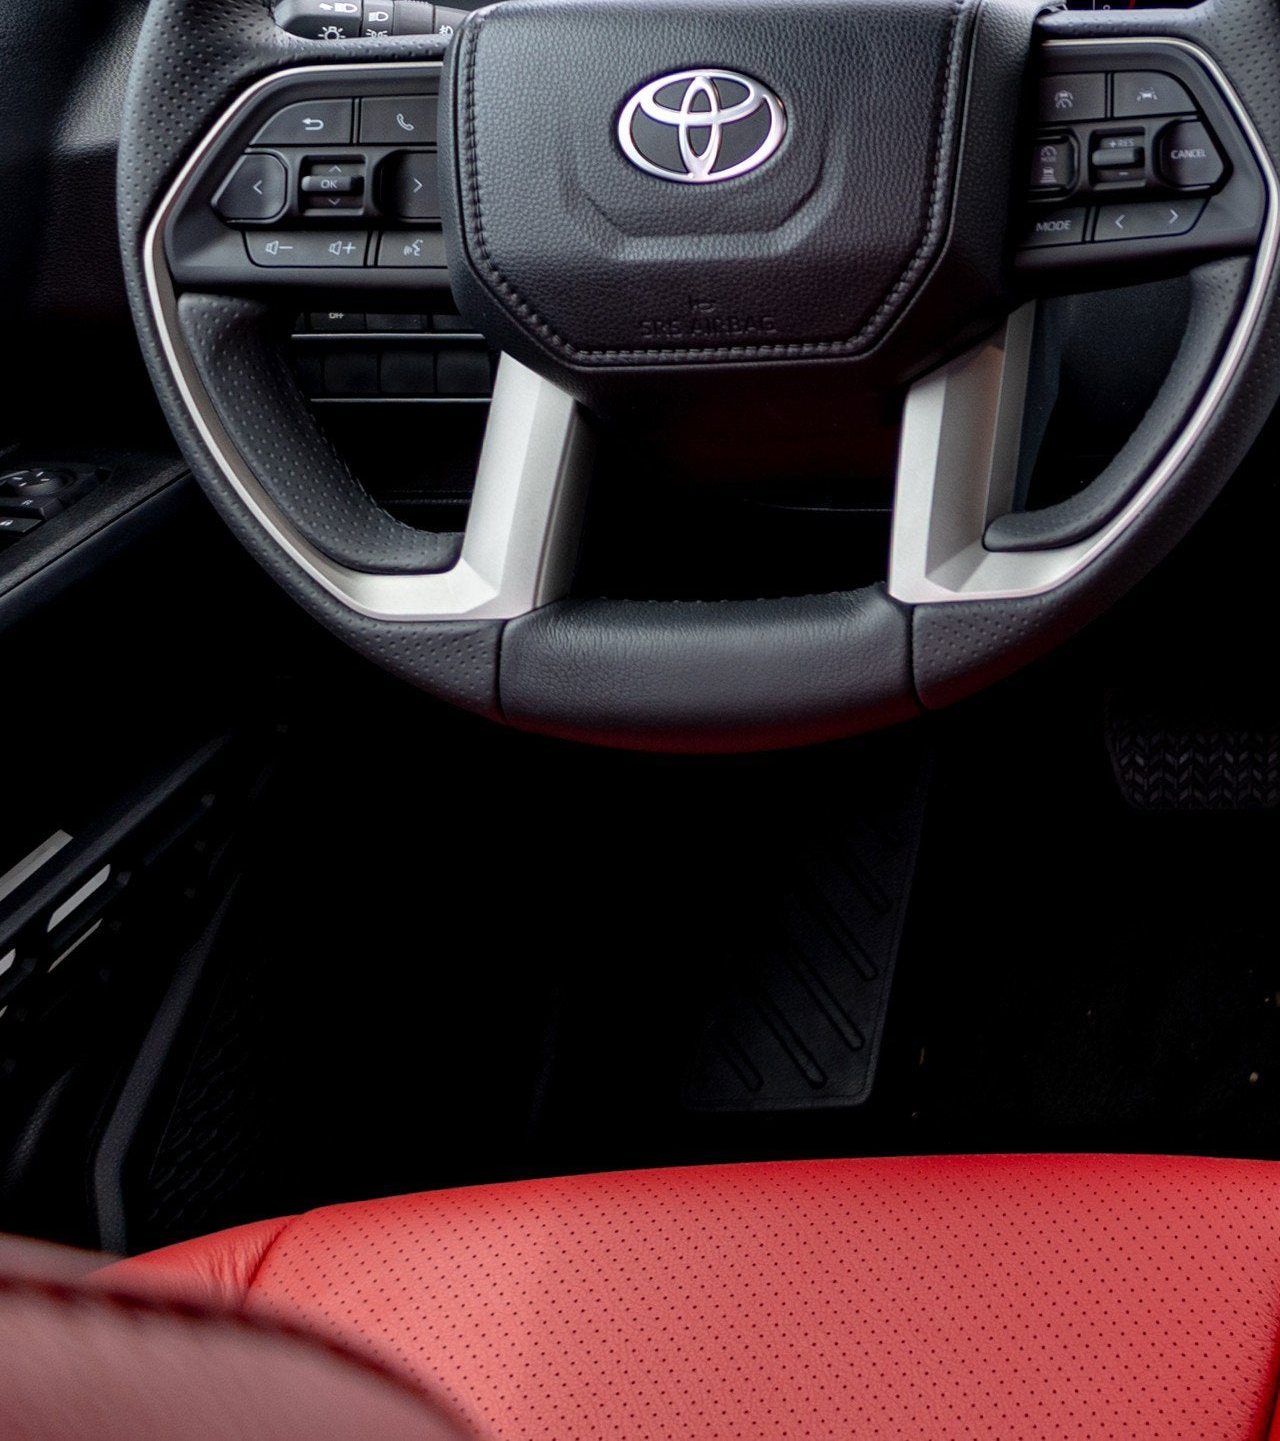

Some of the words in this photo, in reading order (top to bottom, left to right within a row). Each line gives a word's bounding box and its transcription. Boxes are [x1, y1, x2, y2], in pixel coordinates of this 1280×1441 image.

[1171, 148, 1207, 160] CANCEL
[321, 179, 338, 189] OK
[1035, 220, 1072, 232] MODE
